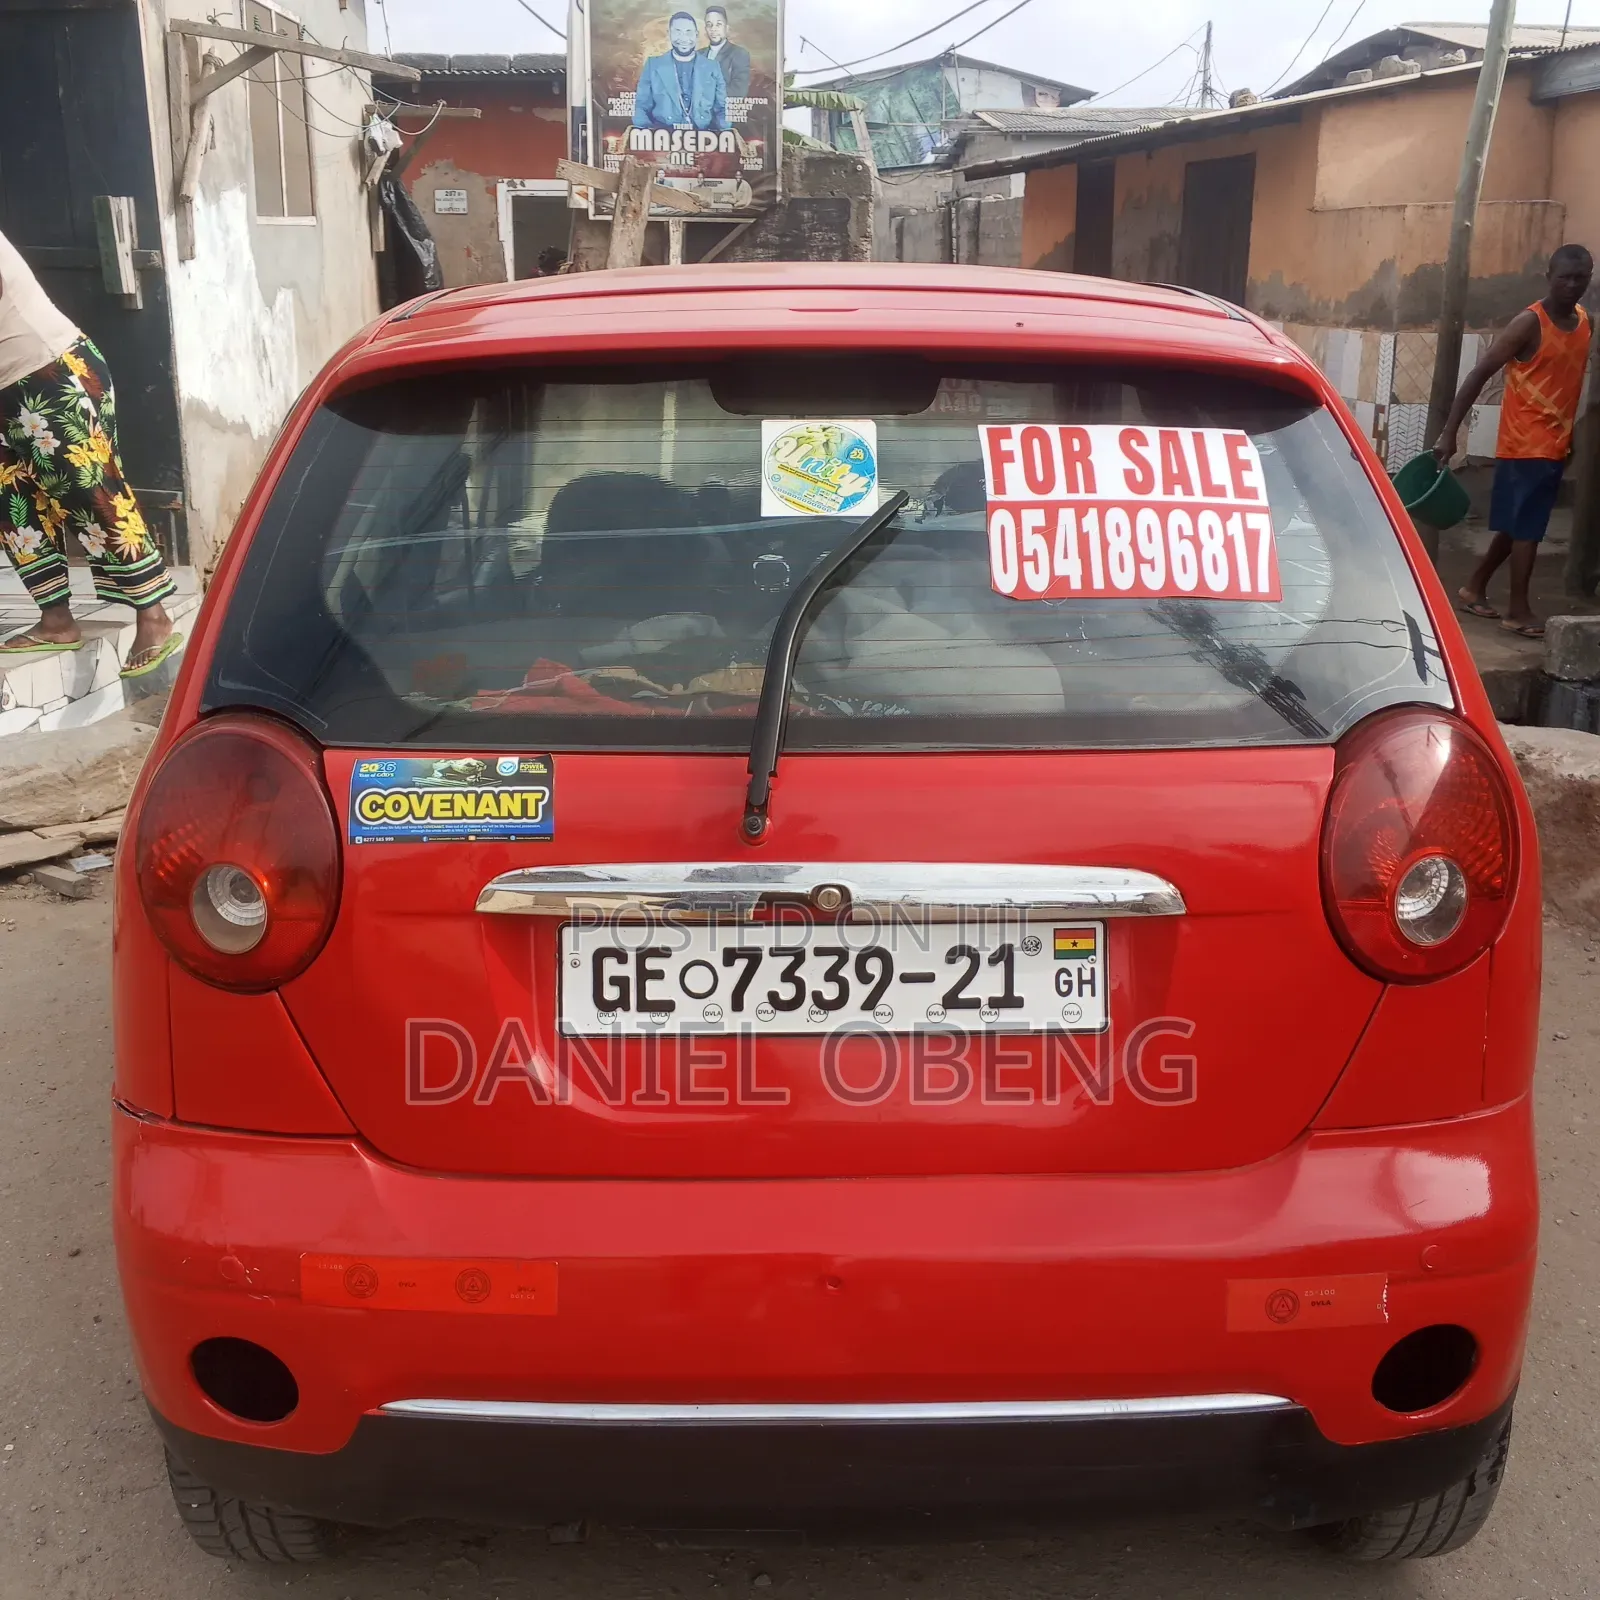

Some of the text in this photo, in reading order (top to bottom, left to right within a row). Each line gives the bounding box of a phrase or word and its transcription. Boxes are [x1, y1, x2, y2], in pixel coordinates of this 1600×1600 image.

[630, 128, 735, 153] MASEDA
[670, 152, 694, 165] NIE
[775, 435, 872, 498] Unity
[986, 426, 1260, 501] FOR SALE
[989, 507, 1273, 595] 0541896817
[360, 761, 397, 773] 2026
[361, 791, 544, 820] COVENANT
[592, 945, 1025, 1013] GE 7339-21
[1054, 967, 1097, 998] GH
[705, 1010, 722, 1018] DVLA
[757, 1008, 774, 1016] DVLA
[810, 1009, 827, 1017] DVLA
[875, 1010, 892, 1018] DVLA
[928, 1010, 945, 1018] DVLA
[981, 1009, 998, 1017] DVLA
